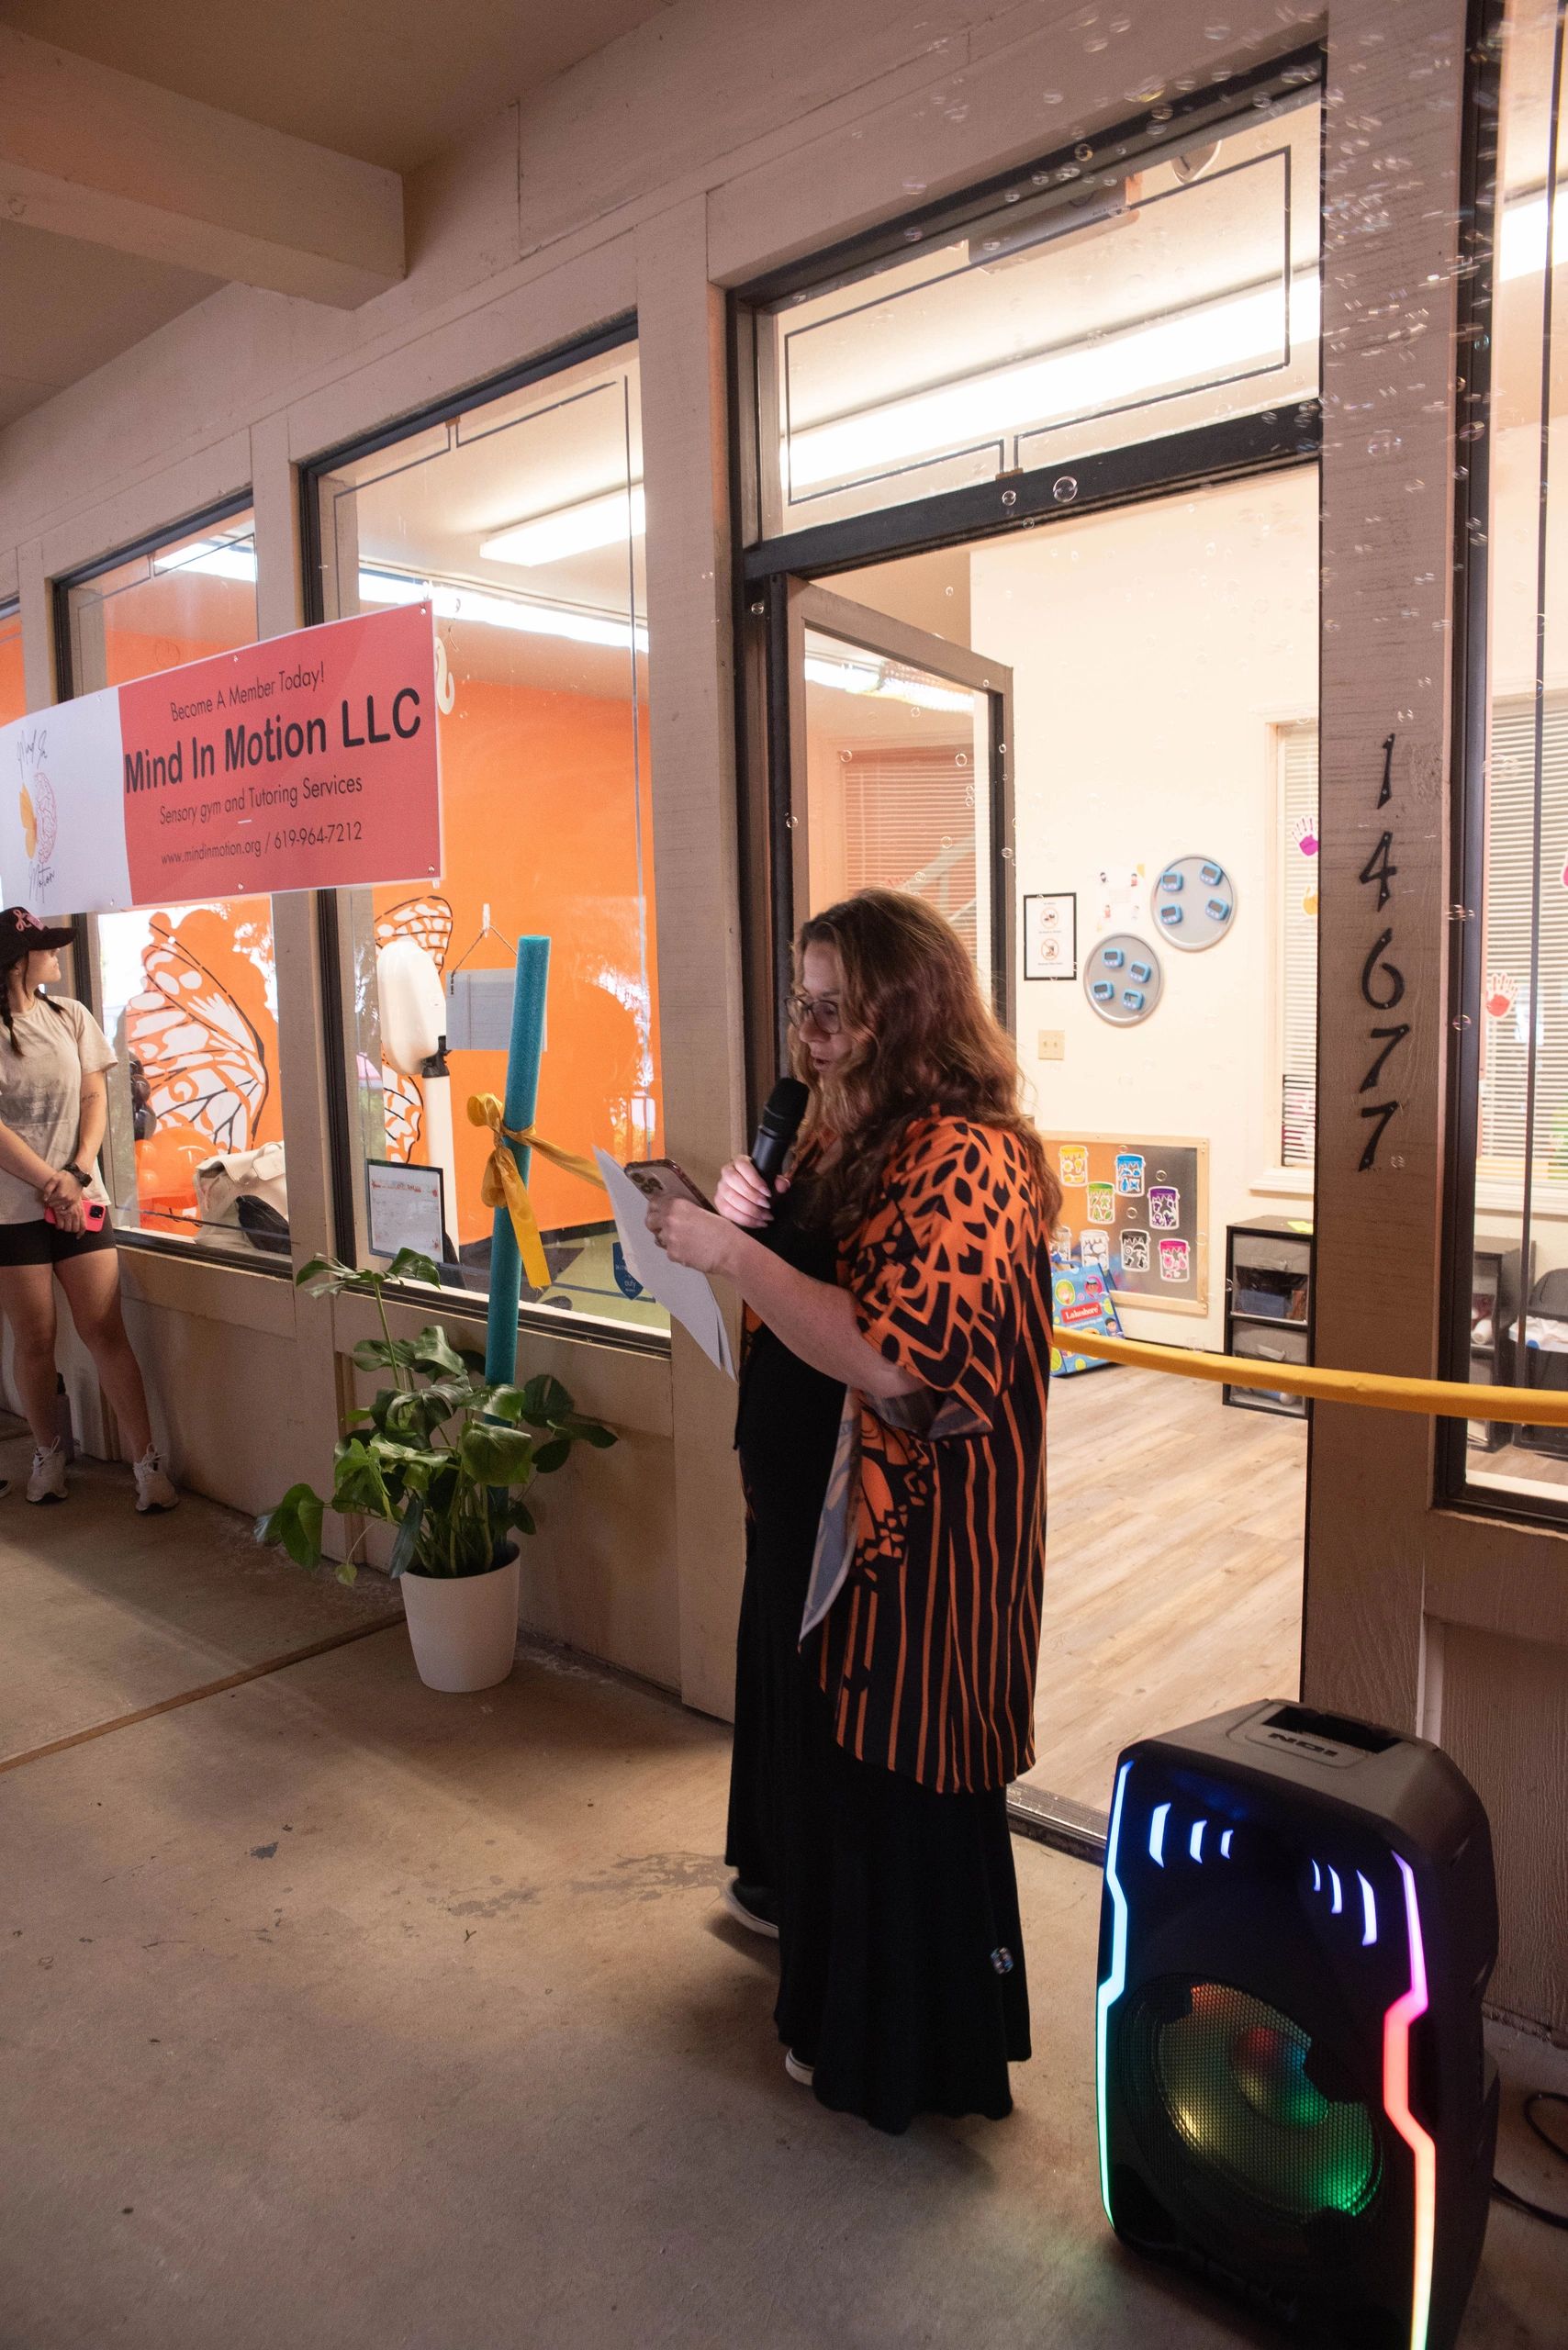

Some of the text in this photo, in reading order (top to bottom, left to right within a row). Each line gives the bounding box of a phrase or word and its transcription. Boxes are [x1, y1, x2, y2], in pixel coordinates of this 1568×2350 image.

[170, 660, 324, 722] Become A Member Today!
[125, 688, 420, 793] Mind In Motion LLC
[160, 775, 363, 825] Sensory gym and Tutoring Services
[161, 822, 362, 865] www.mindinmotion.org / 619-964-7212
[1357, 733, 1410, 1172] 14677
[1065, 1306, 1100, 1320] Lakeshore
